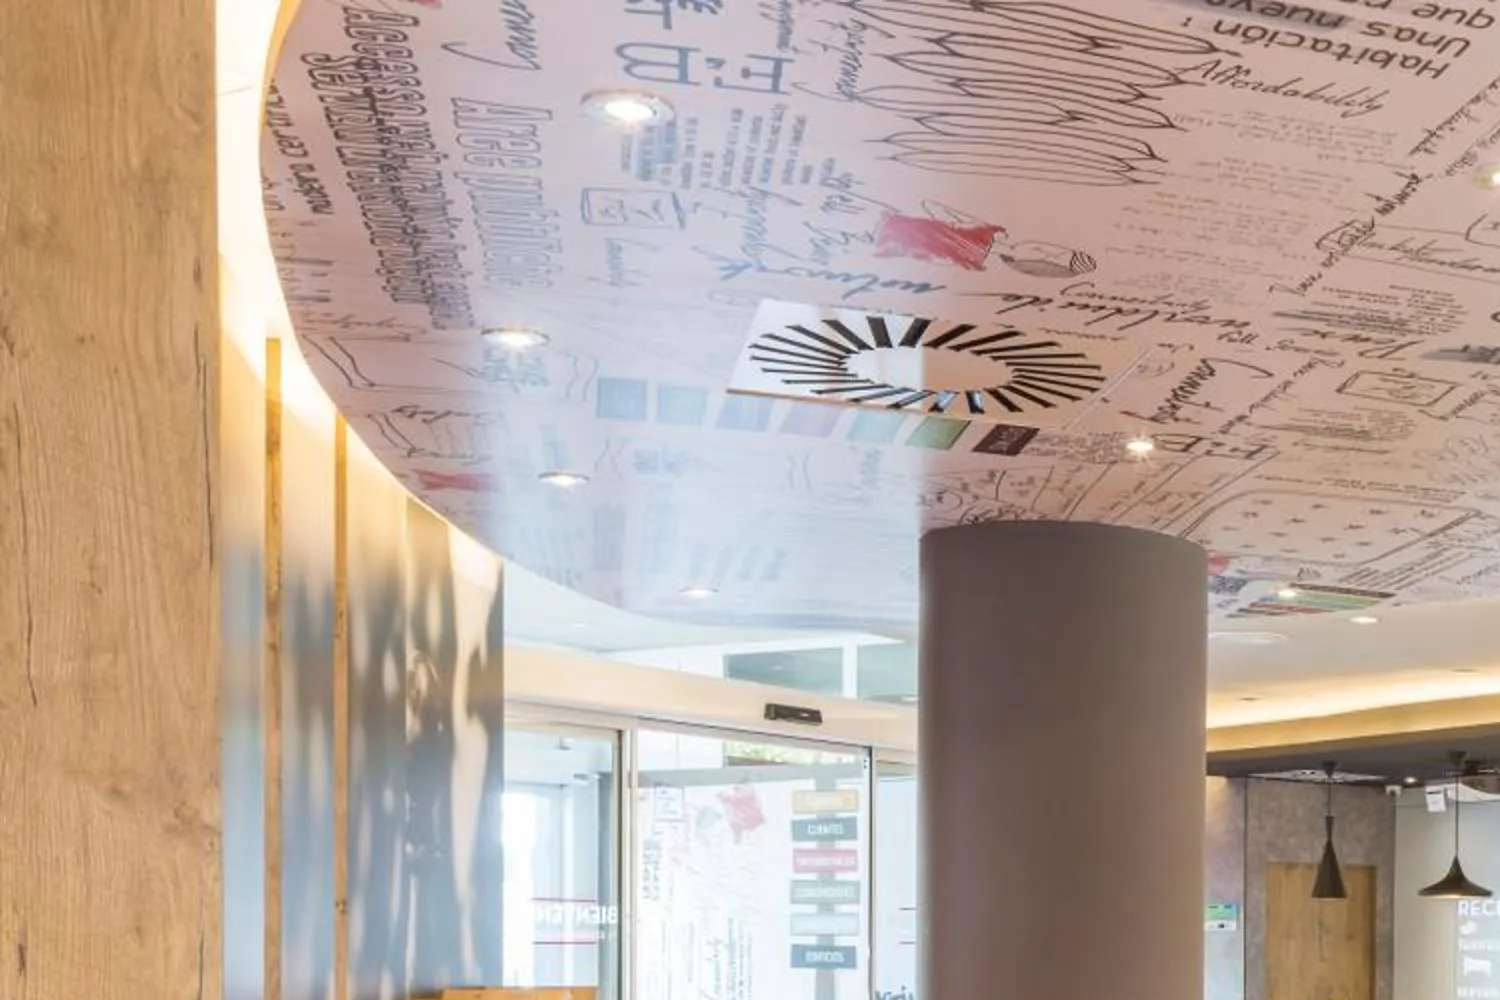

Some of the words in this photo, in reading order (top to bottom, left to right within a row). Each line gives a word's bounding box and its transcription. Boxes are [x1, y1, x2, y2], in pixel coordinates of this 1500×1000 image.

[1360, 19, 1471, 58] Unas
[1411, 0, 1495, 30] que
[1212, 19, 1450, 80] Habitación
[1176, 58, 1390, 119] Affordability
